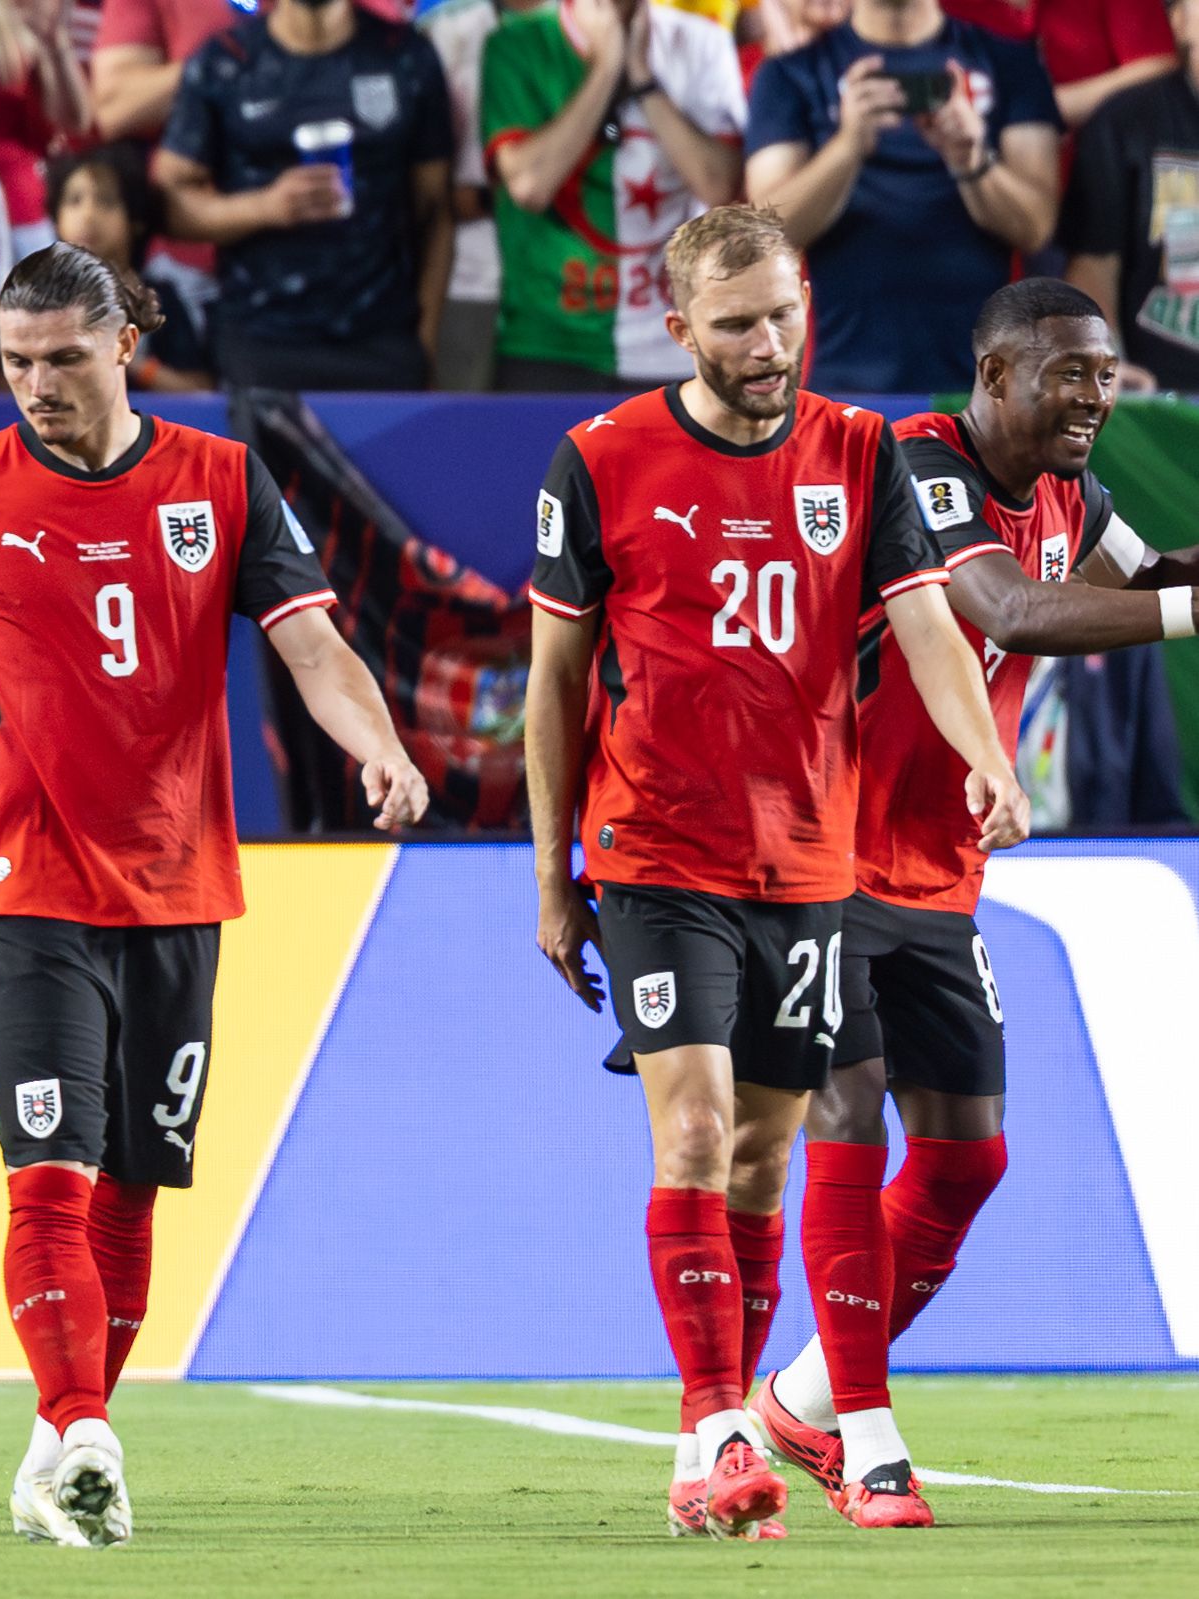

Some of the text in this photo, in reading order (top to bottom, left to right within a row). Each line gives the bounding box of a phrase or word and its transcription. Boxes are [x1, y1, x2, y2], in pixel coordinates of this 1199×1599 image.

[95, 582, 139, 678] 9
[711, 559, 797, 655] 20
[773, 931, 843, 1034] 20
[153, 1041, 207, 1128] 9
[825, 1290, 881, 1311] ÖFB
